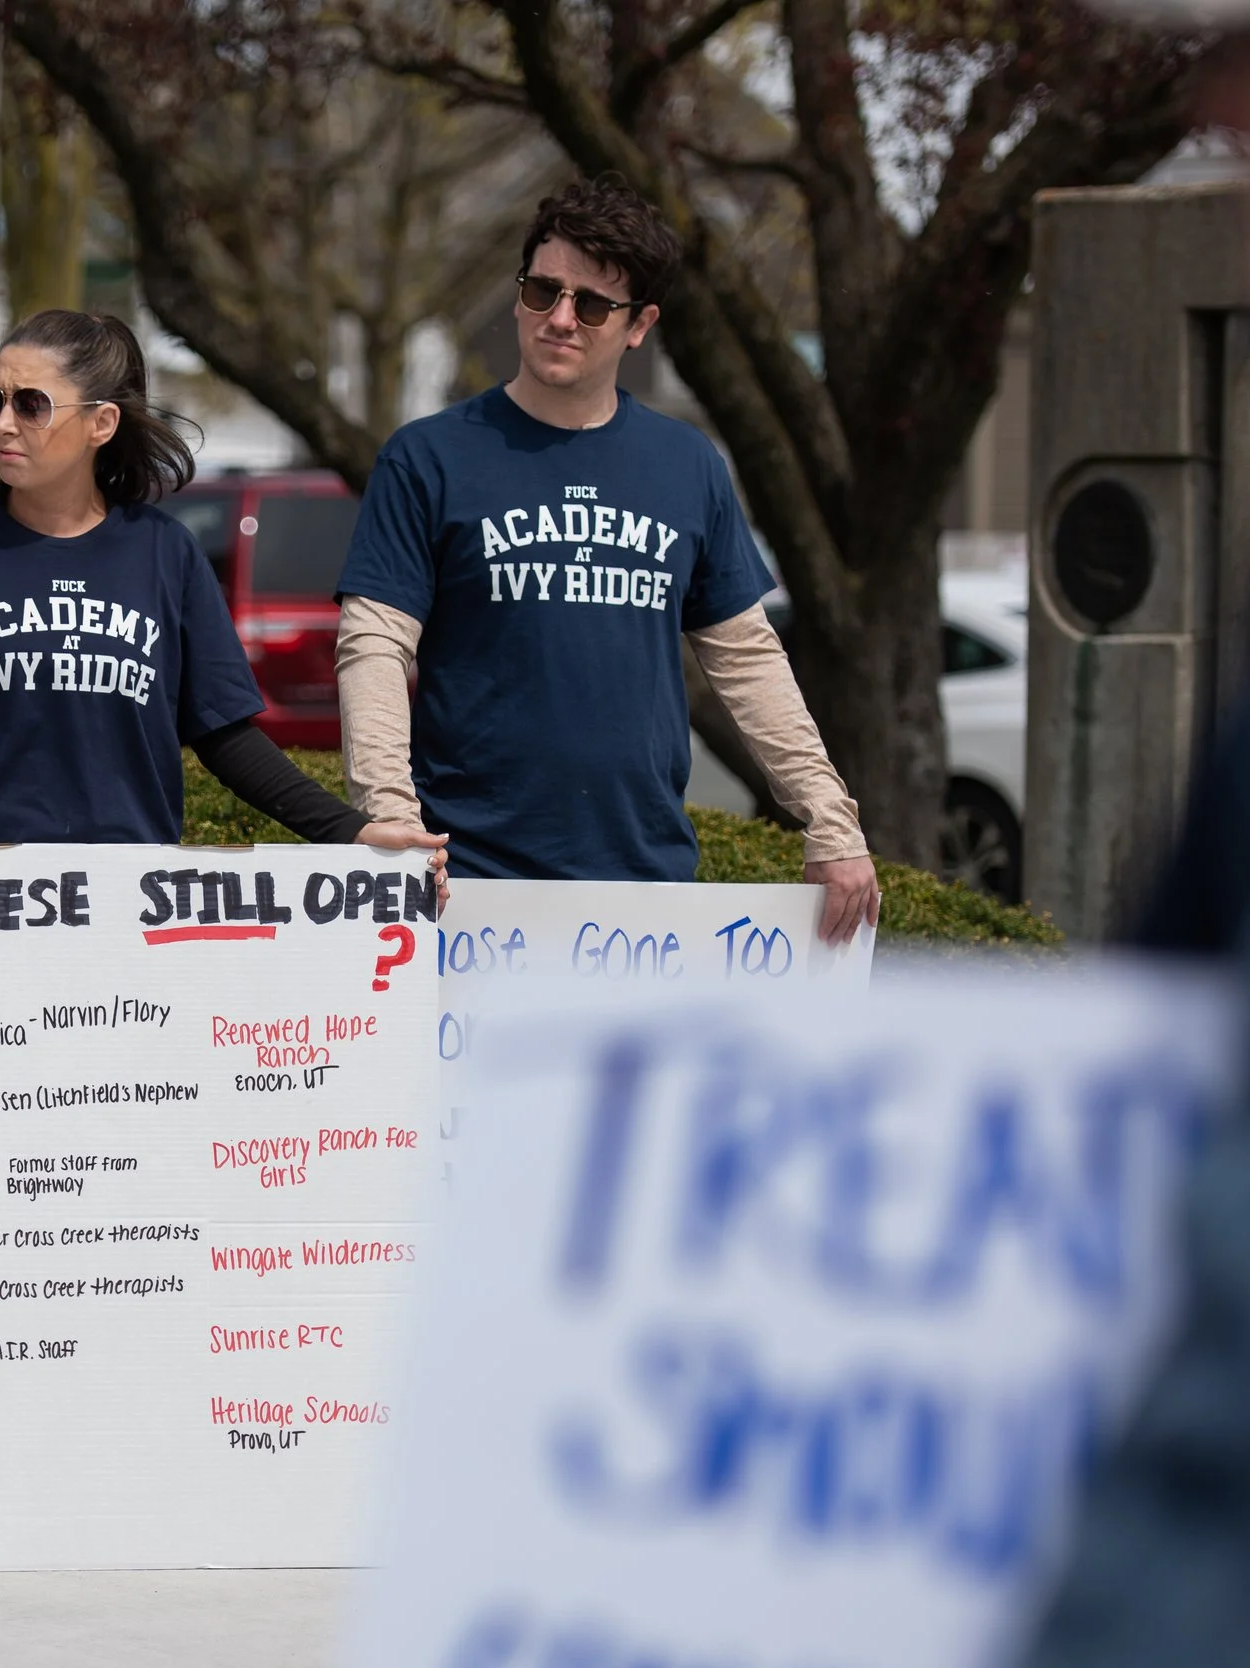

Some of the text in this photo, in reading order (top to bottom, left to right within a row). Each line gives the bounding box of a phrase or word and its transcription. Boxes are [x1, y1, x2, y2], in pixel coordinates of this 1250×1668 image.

[564, 485, 599, 500] FUCK
[479, 502, 680, 564] ACADEMY
[574, 546, 593, 563] AT
[51, 579, 87, 593] FUCK
[489, 562, 673, 611] IVY RIDGE
[62, 634, 81, 650] AT
[51, 652, 157, 706] RIDGE
[139, 868, 292, 926] STILL
[302, 868, 437, 925] OPEN
[371, 923, 417, 993] ?
[212, 1014, 377, 1047] Renewed Hope
[255, 1044, 330, 1068] Ranch
[303, 1065, 340, 1089] UT
[135, 1081, 199, 1106] Nephew
[211, 1136, 311, 1169] Discovery
[318, 1127, 378, 1156] Ranch
[9, 1157, 56, 1174] Former
[101, 1156, 138, 1172] from
[259, 1164, 308, 1189] Girls
[6, 1176, 84, 1202] Brightway
[14, 1229, 55, 1248] Cross
[60, 1227, 104, 1246] Creek
[108, 1223, 200, 1243] therapists
[210, 1238, 416, 1277] Wingate Wilderness
[43, 1279, 87, 1299] Creek
[90, 1274, 184, 1297] therapists
[209, 1324, 343, 1354] Sunrise RTC
[301, 1396, 392, 1425] Schools
